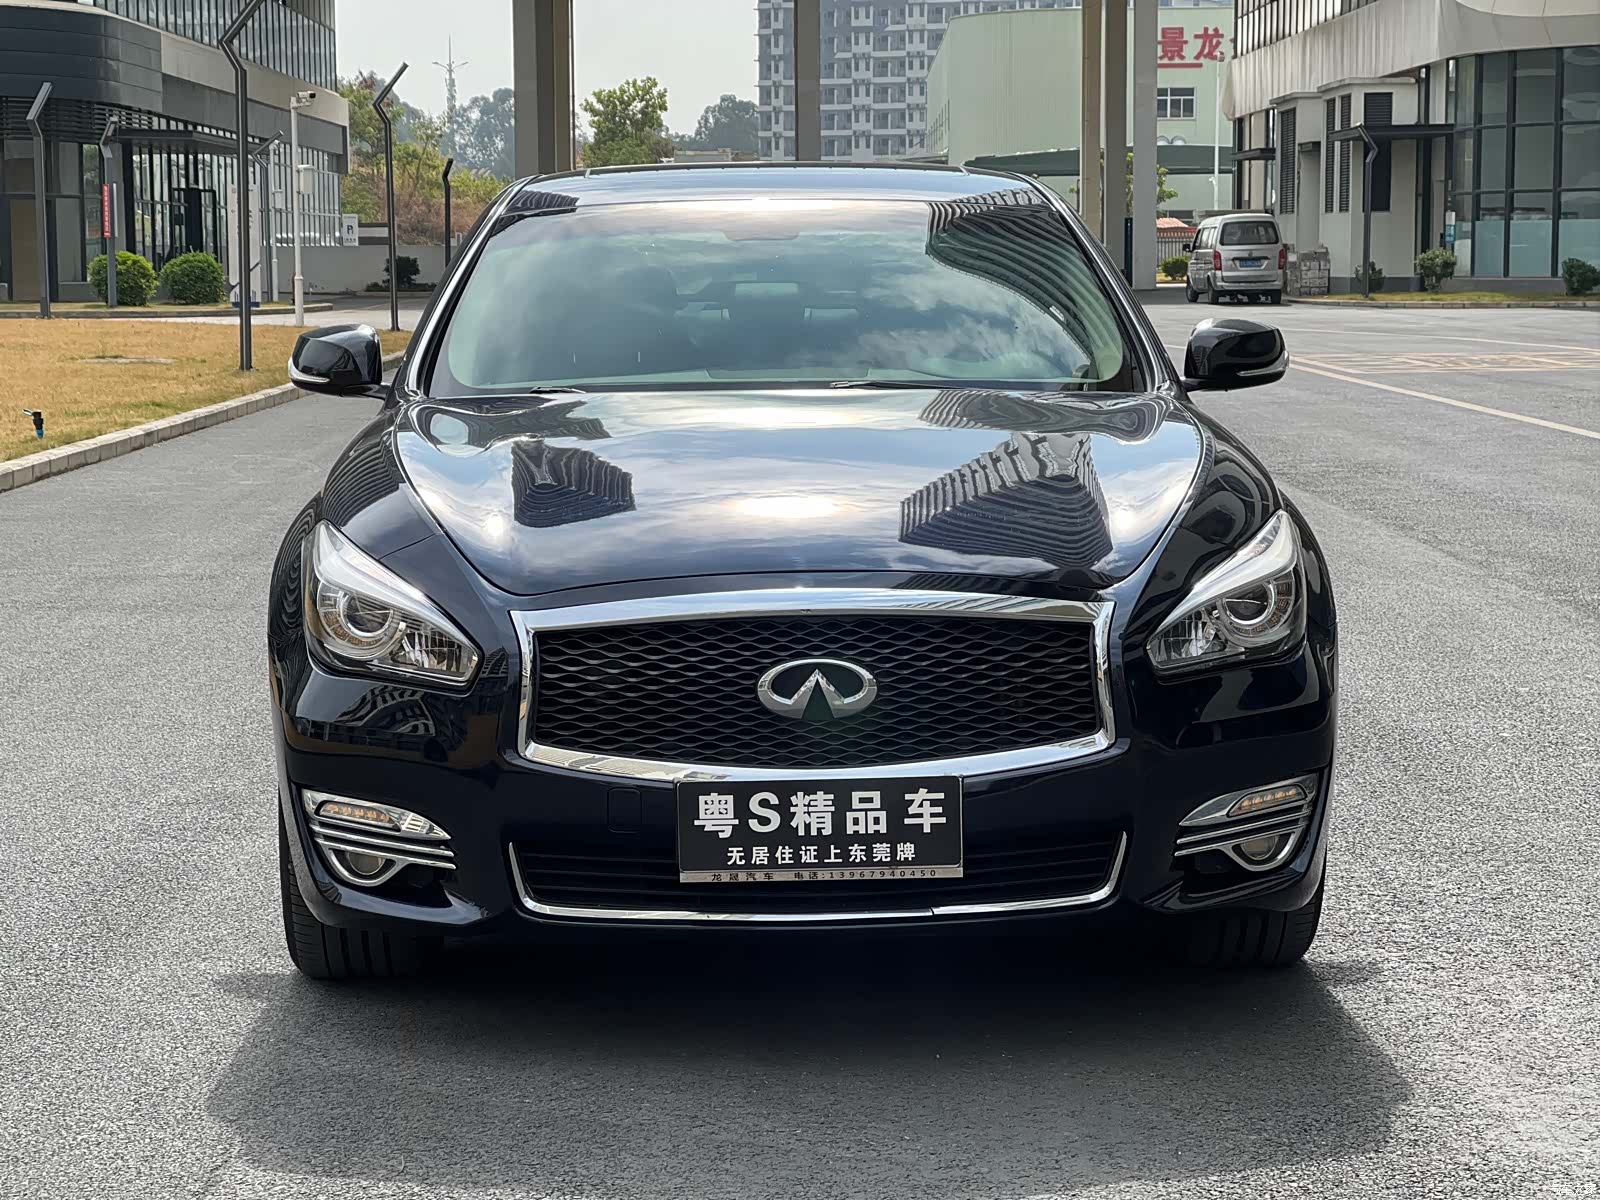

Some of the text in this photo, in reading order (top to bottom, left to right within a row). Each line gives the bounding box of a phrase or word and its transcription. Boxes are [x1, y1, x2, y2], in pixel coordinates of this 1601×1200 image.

[1157, 26, 1233, 61] 景龙
[694, 788, 946, 839] 粤S精品车
[727, 842, 915, 865] 无居住证上东莞牌
